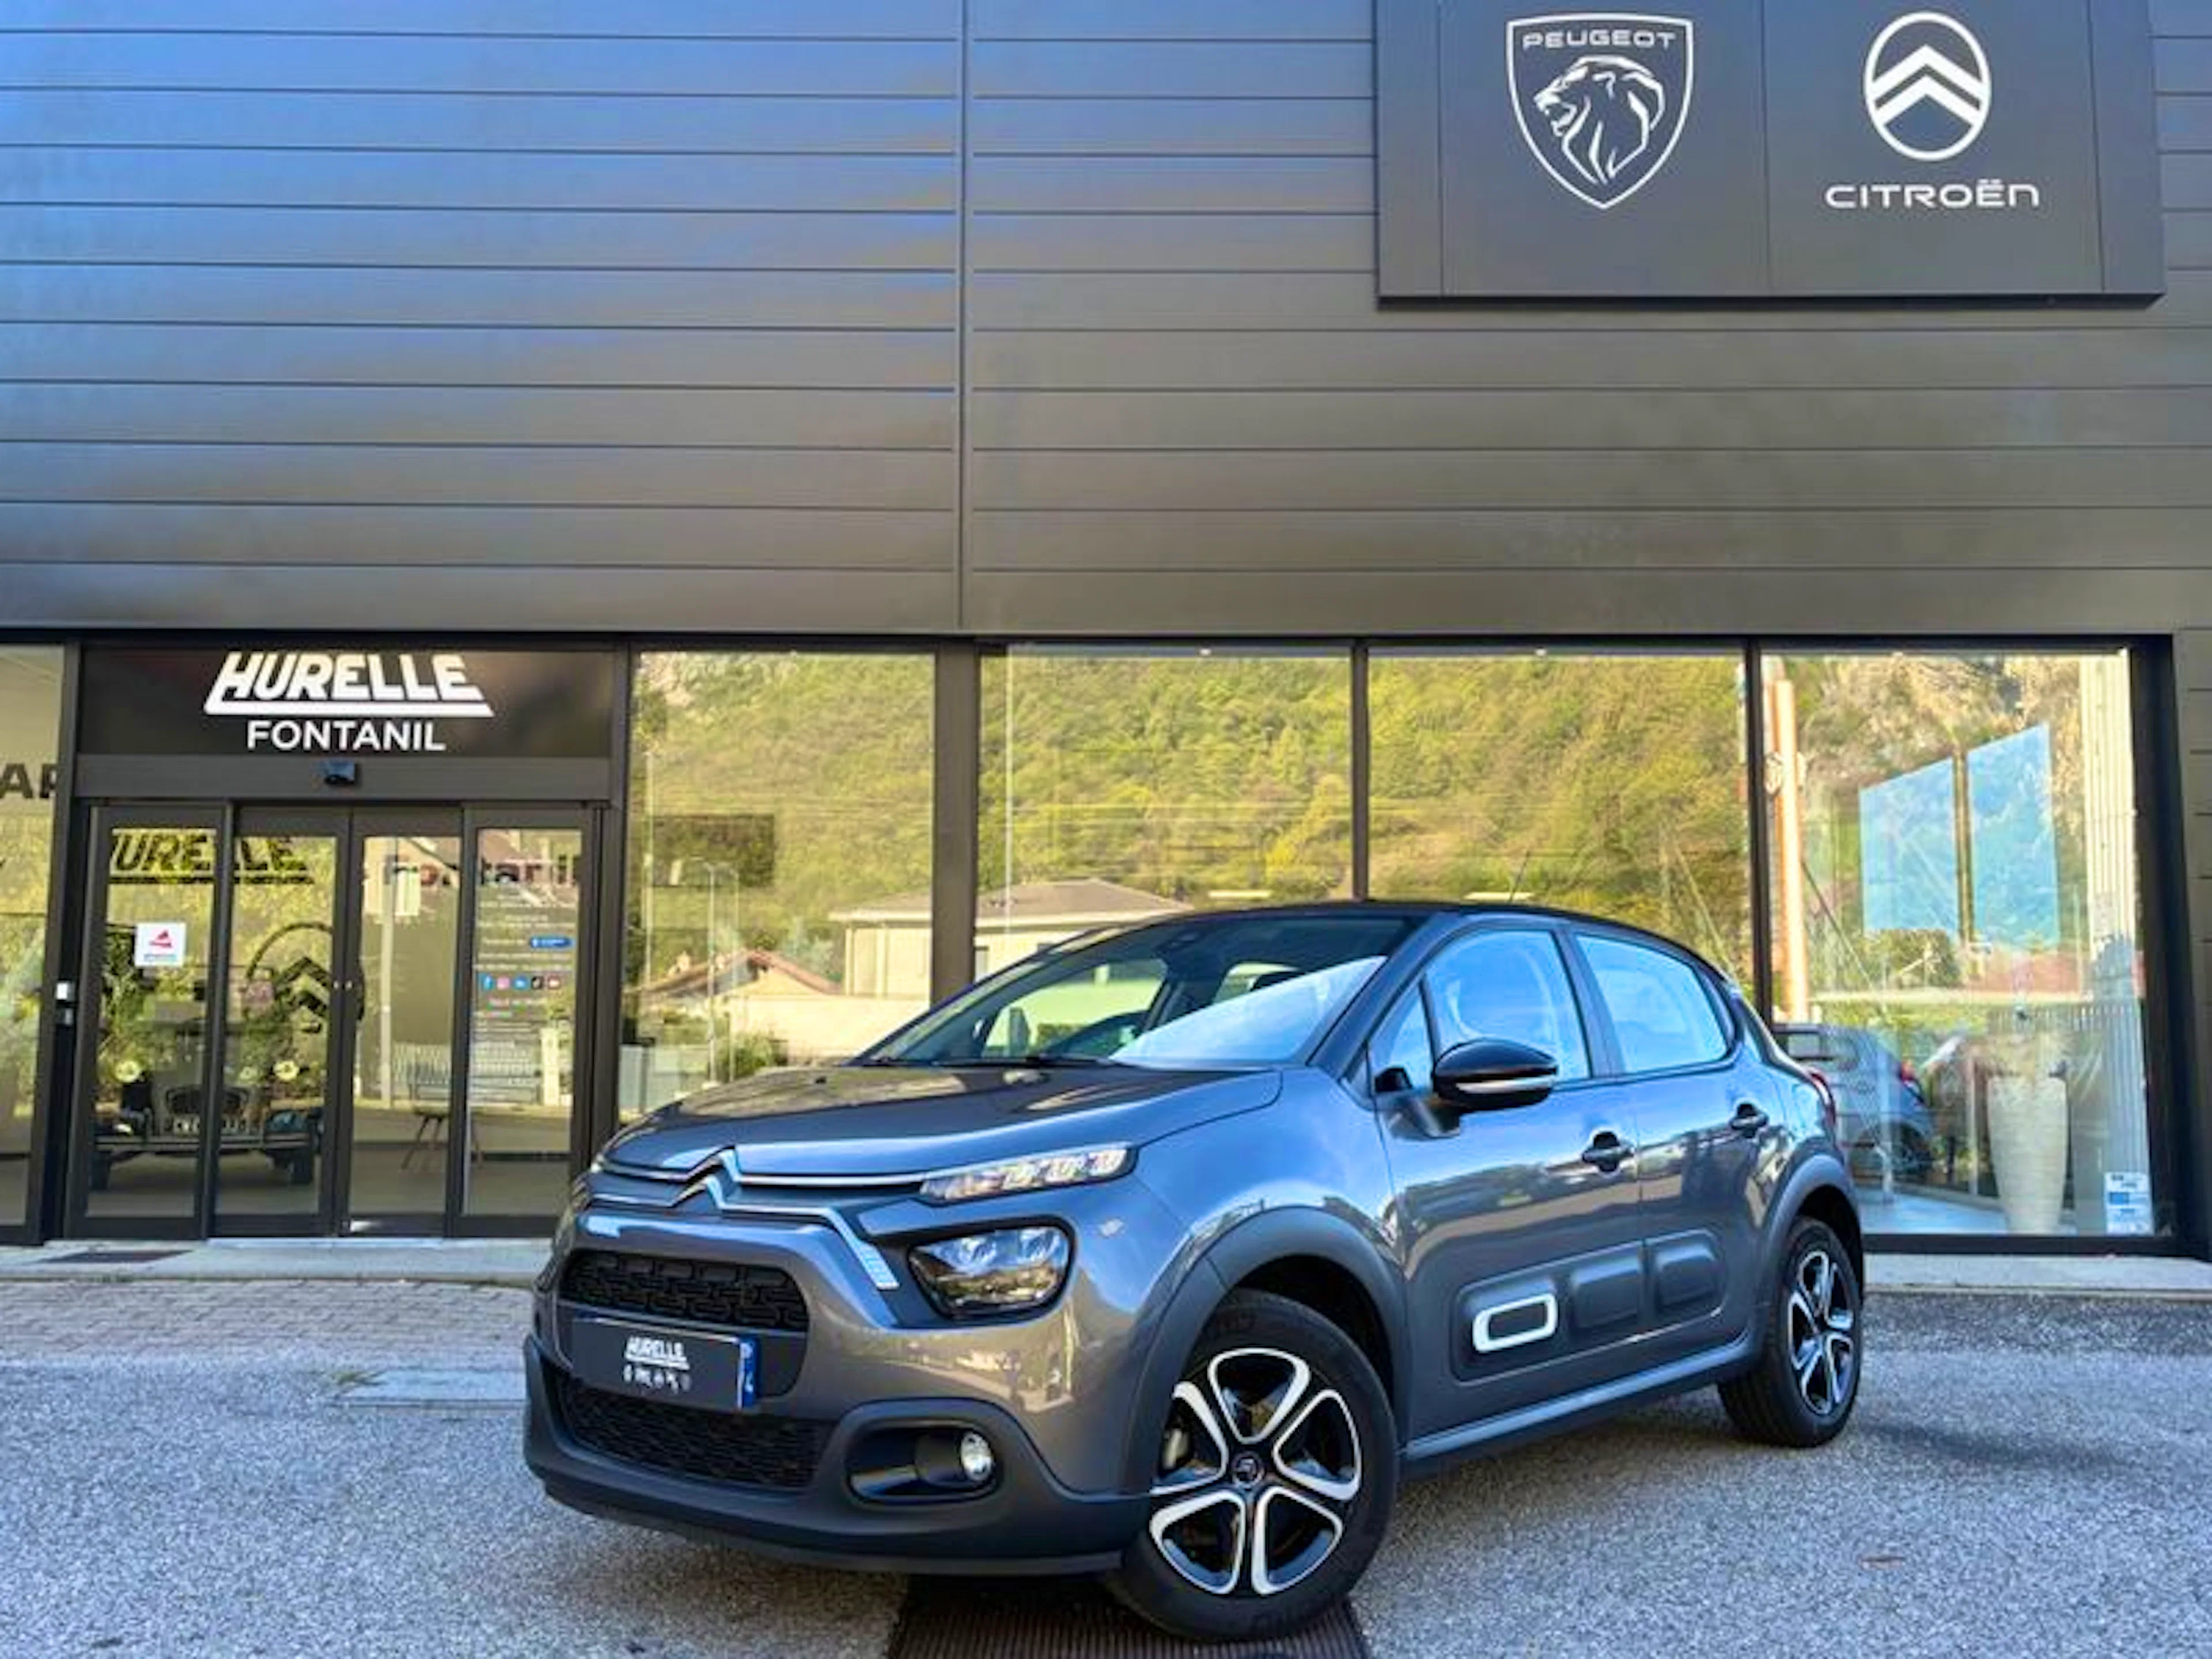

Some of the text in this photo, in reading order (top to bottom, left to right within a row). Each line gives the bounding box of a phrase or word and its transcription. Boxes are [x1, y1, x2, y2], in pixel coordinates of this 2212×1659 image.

[1522, 29, 1677, 50] PEUGEOT
[1824, 179, 2040, 209] CITROËN
[203, 651, 494, 715] HURELLE
[247, 719, 446, 751] FONTANIL
